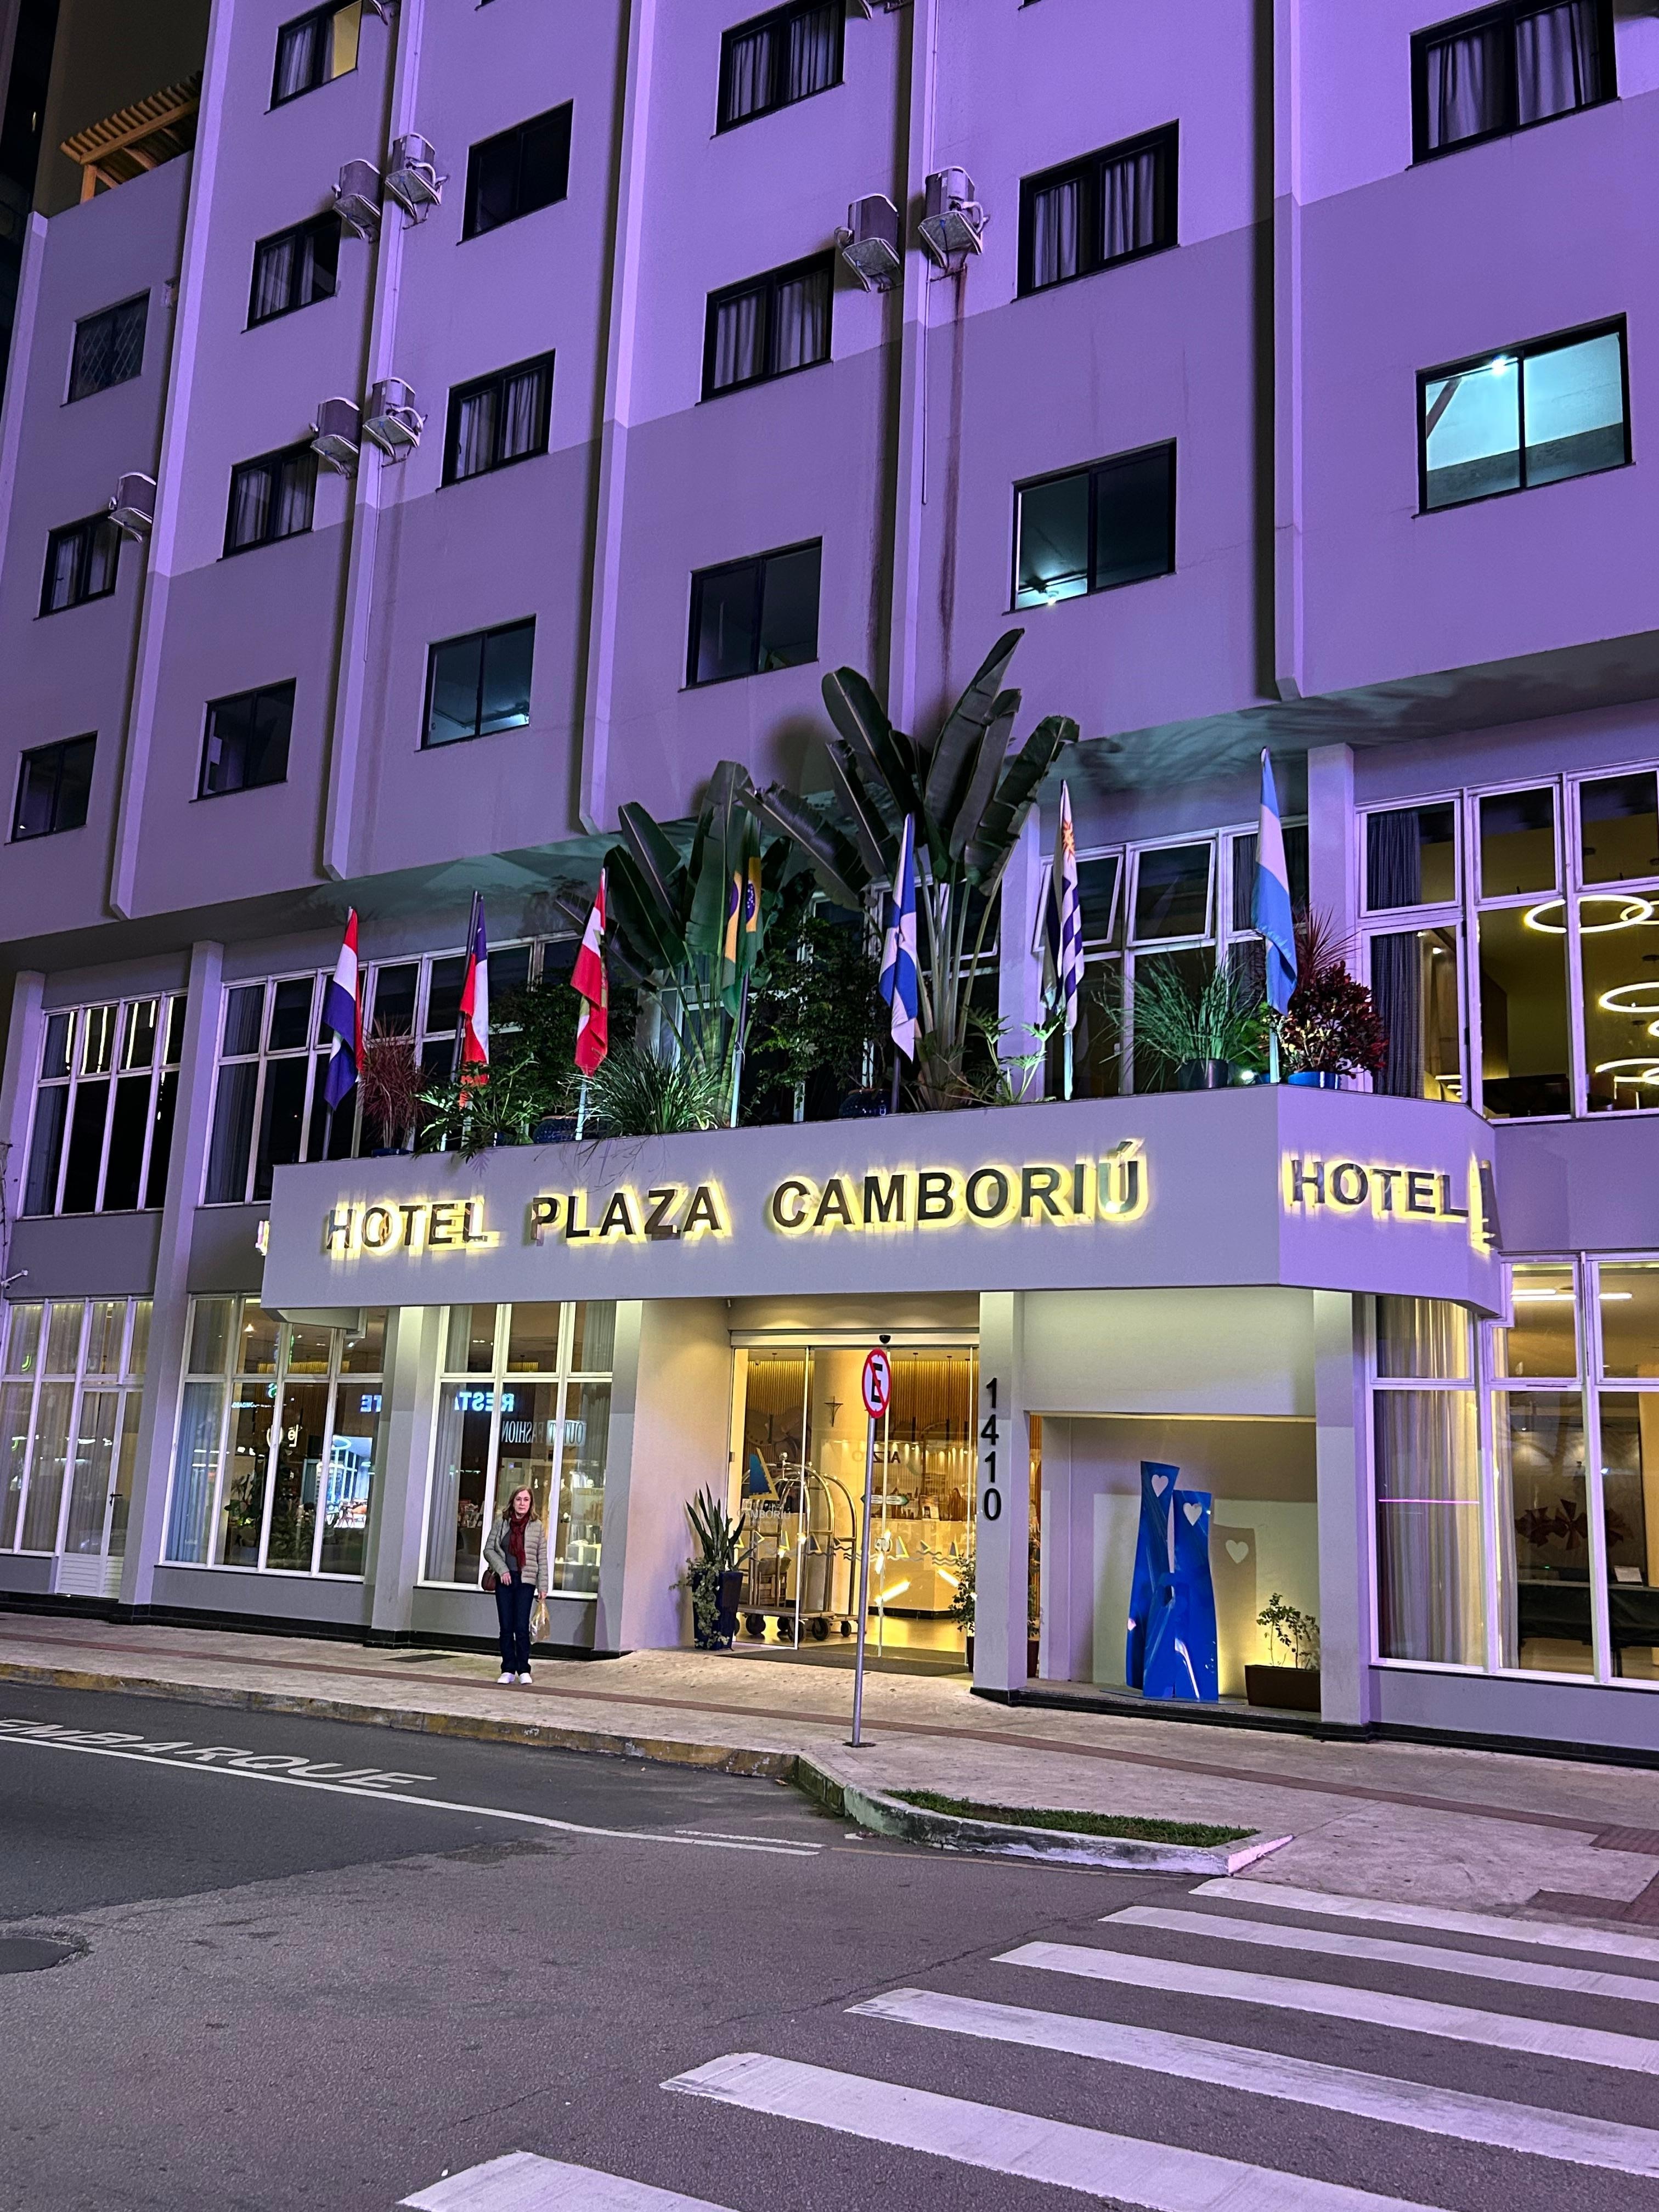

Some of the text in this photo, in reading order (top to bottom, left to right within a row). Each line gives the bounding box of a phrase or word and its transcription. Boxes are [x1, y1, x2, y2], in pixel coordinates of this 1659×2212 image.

[326, 1200, 489, 1250] HOTEL
[531, 1186, 723, 1241] PLAZA
[772, 1141, 1140, 1228] CAMBORIÚ
[1291, 1159, 1469, 1218] HOTEL
[870, 1362, 883, 1403] E
[981, 1378, 1002, 1520] 1410
